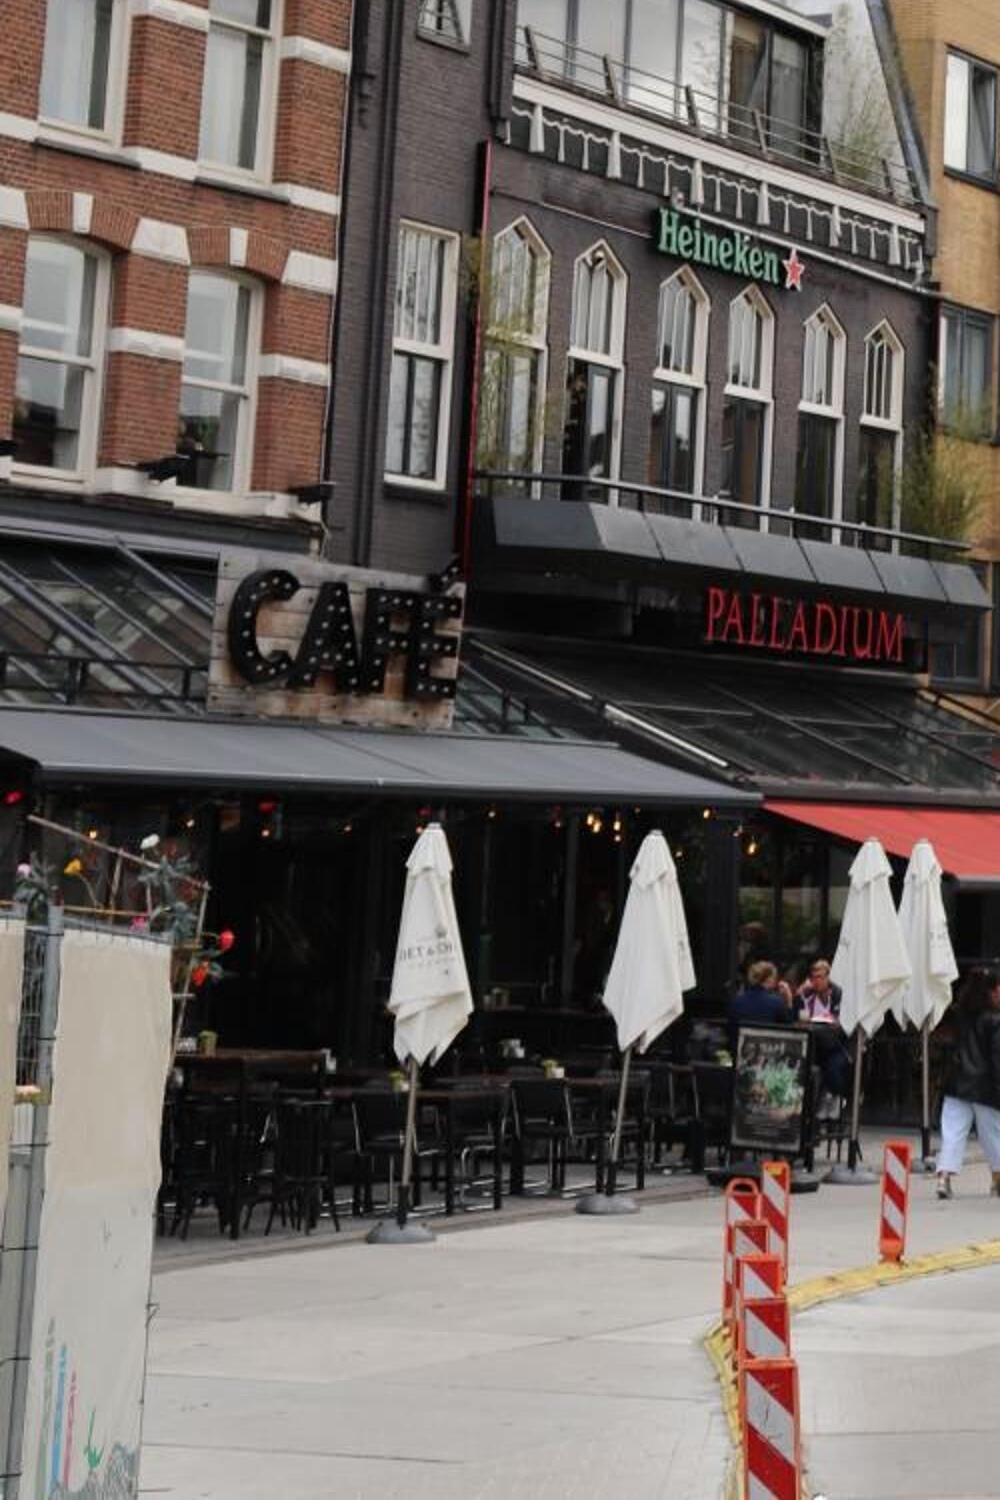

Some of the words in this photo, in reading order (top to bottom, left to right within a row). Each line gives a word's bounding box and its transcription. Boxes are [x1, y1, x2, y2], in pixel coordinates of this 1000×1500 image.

[659, 208, 779, 284] Heineken
[229, 553, 462, 702] CAFÉ
[704, 585, 905, 662] PALLADIUM
